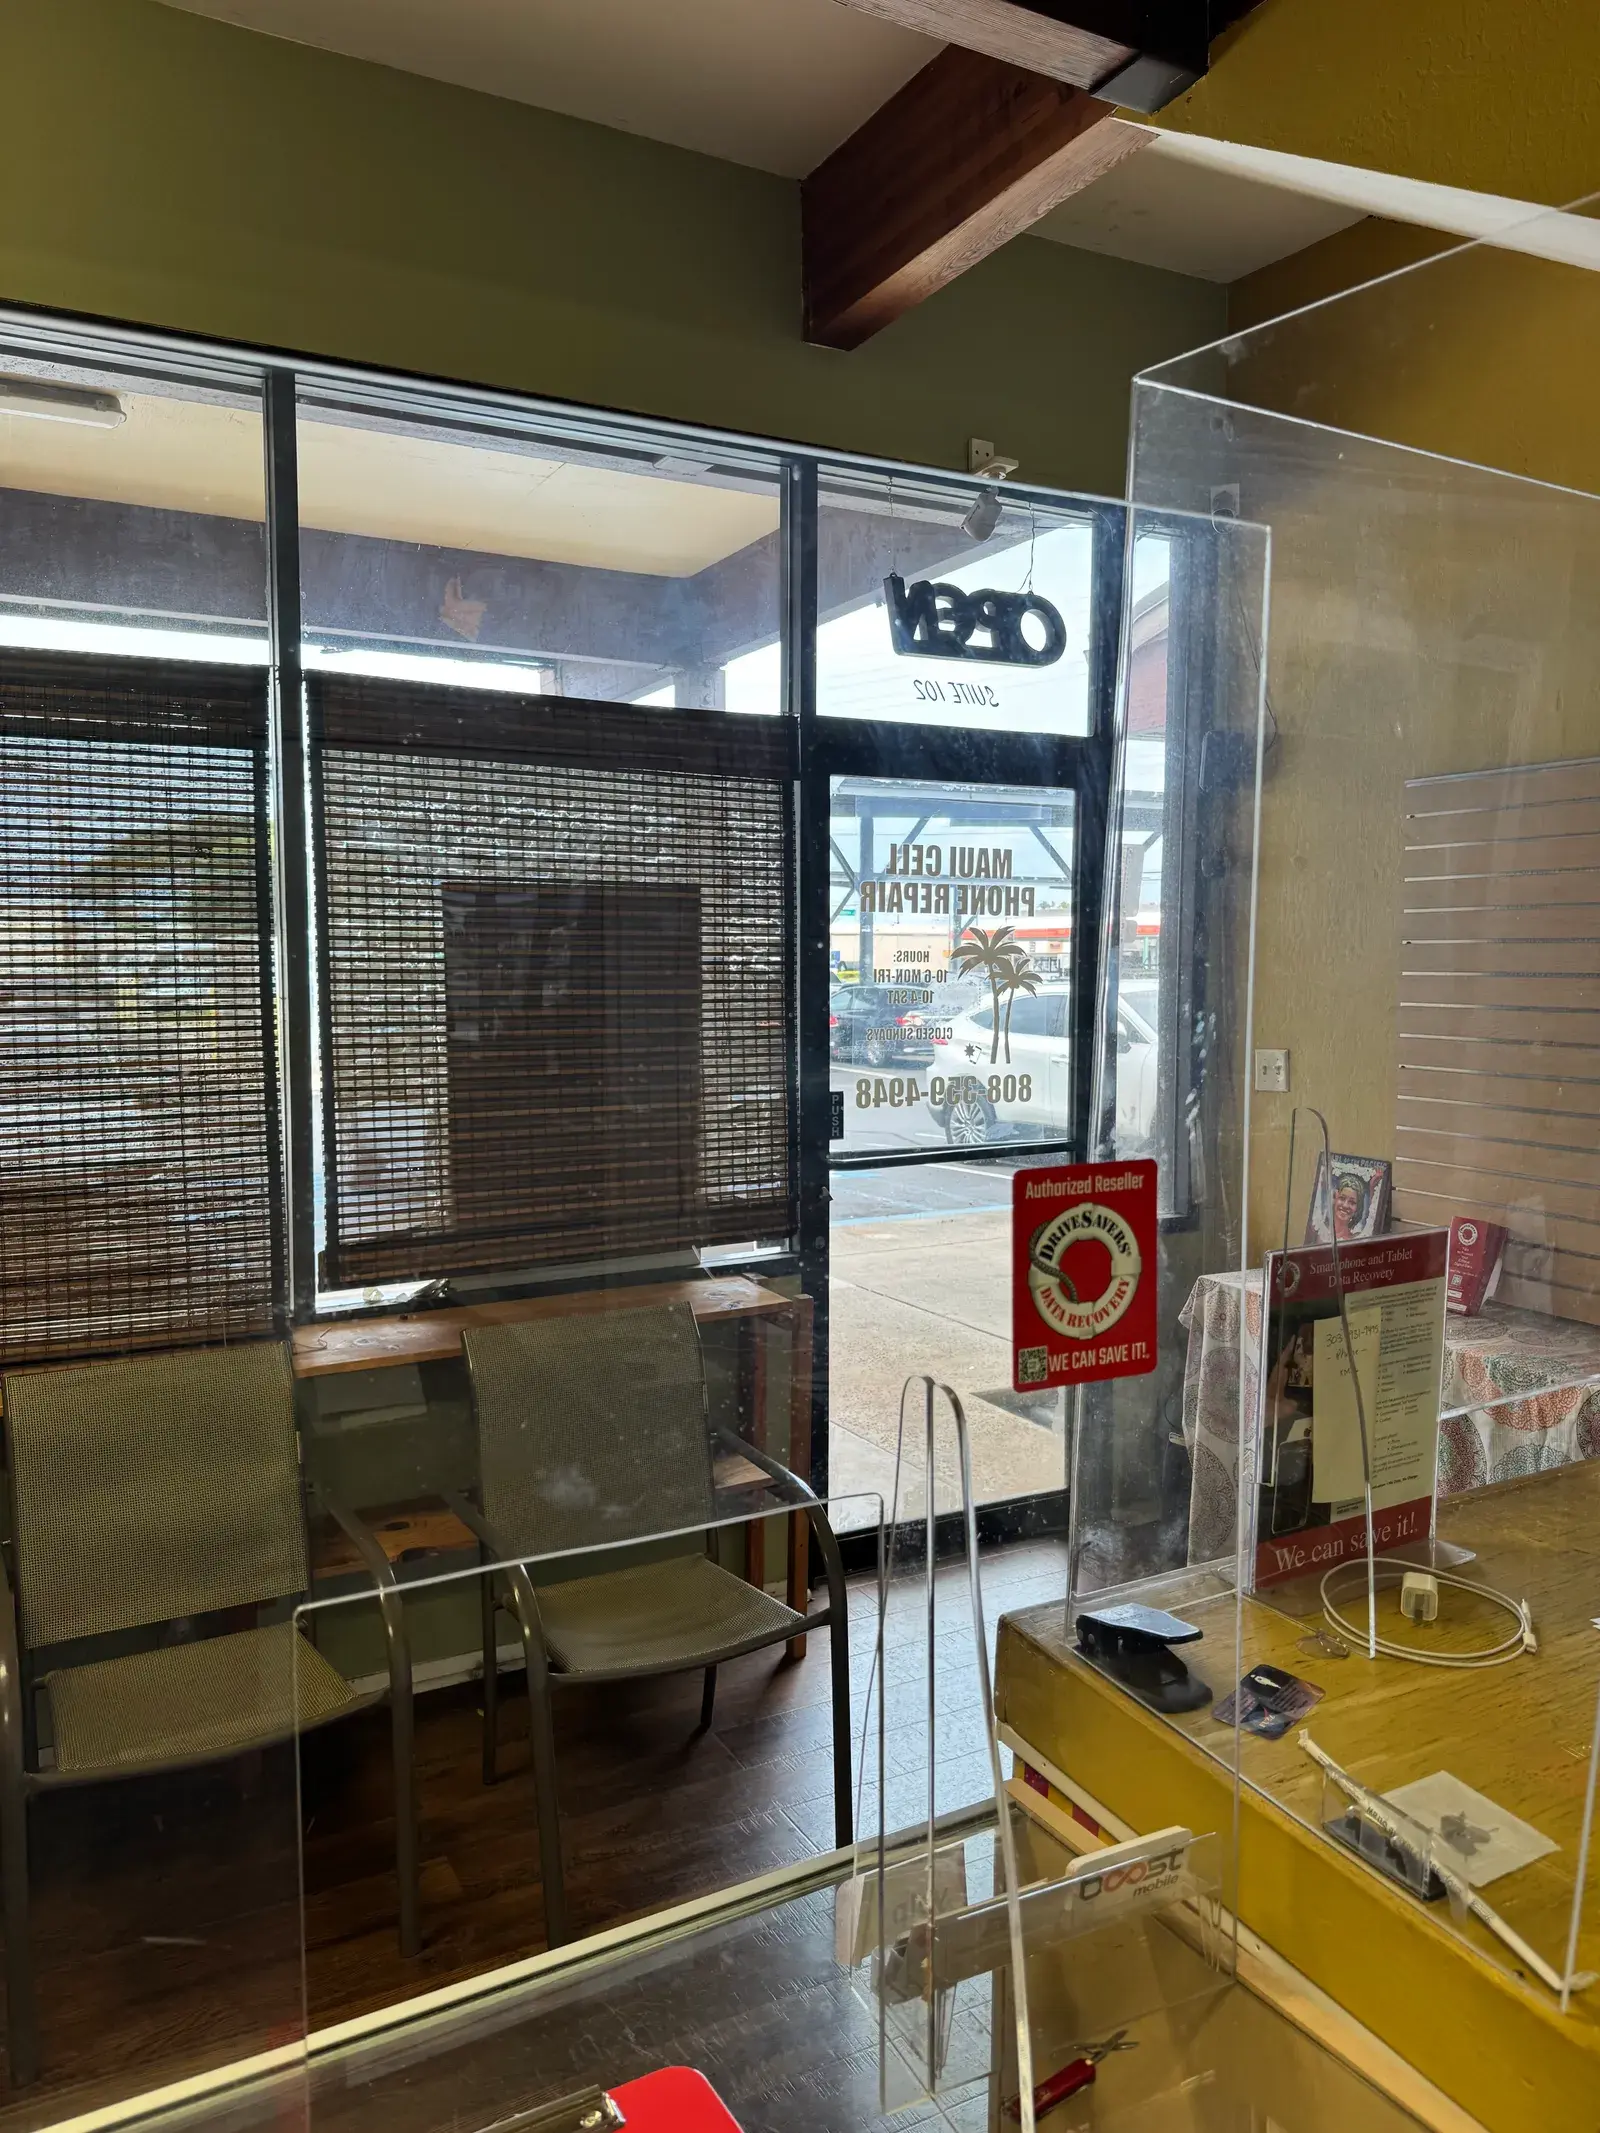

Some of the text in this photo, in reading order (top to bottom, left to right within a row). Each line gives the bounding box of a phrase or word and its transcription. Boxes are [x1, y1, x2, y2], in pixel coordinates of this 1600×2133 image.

[831, 1094, 840, 1137] PUSH
[1025, 1172, 1144, 1200] Authorized Reseller
[1309, 1249, 1413, 1275] Smarphone and Tablet
[1328, 1268, 1395, 1288] Dta Recovery
[1040, 1277, 1131, 1328] DATA RECOVERY
[1050, 1352, 1069, 1373] WE
[1072, 1348, 1096, 1368] CAN
[1099, 1343, 1129, 1365] SAVE
[1274, 1545, 1306, 1572] We
[1311, 1539, 1344, 1562] can
[1350, 1525, 1391, 1553] save
[1133, 1873, 1179, 1897] mobile
